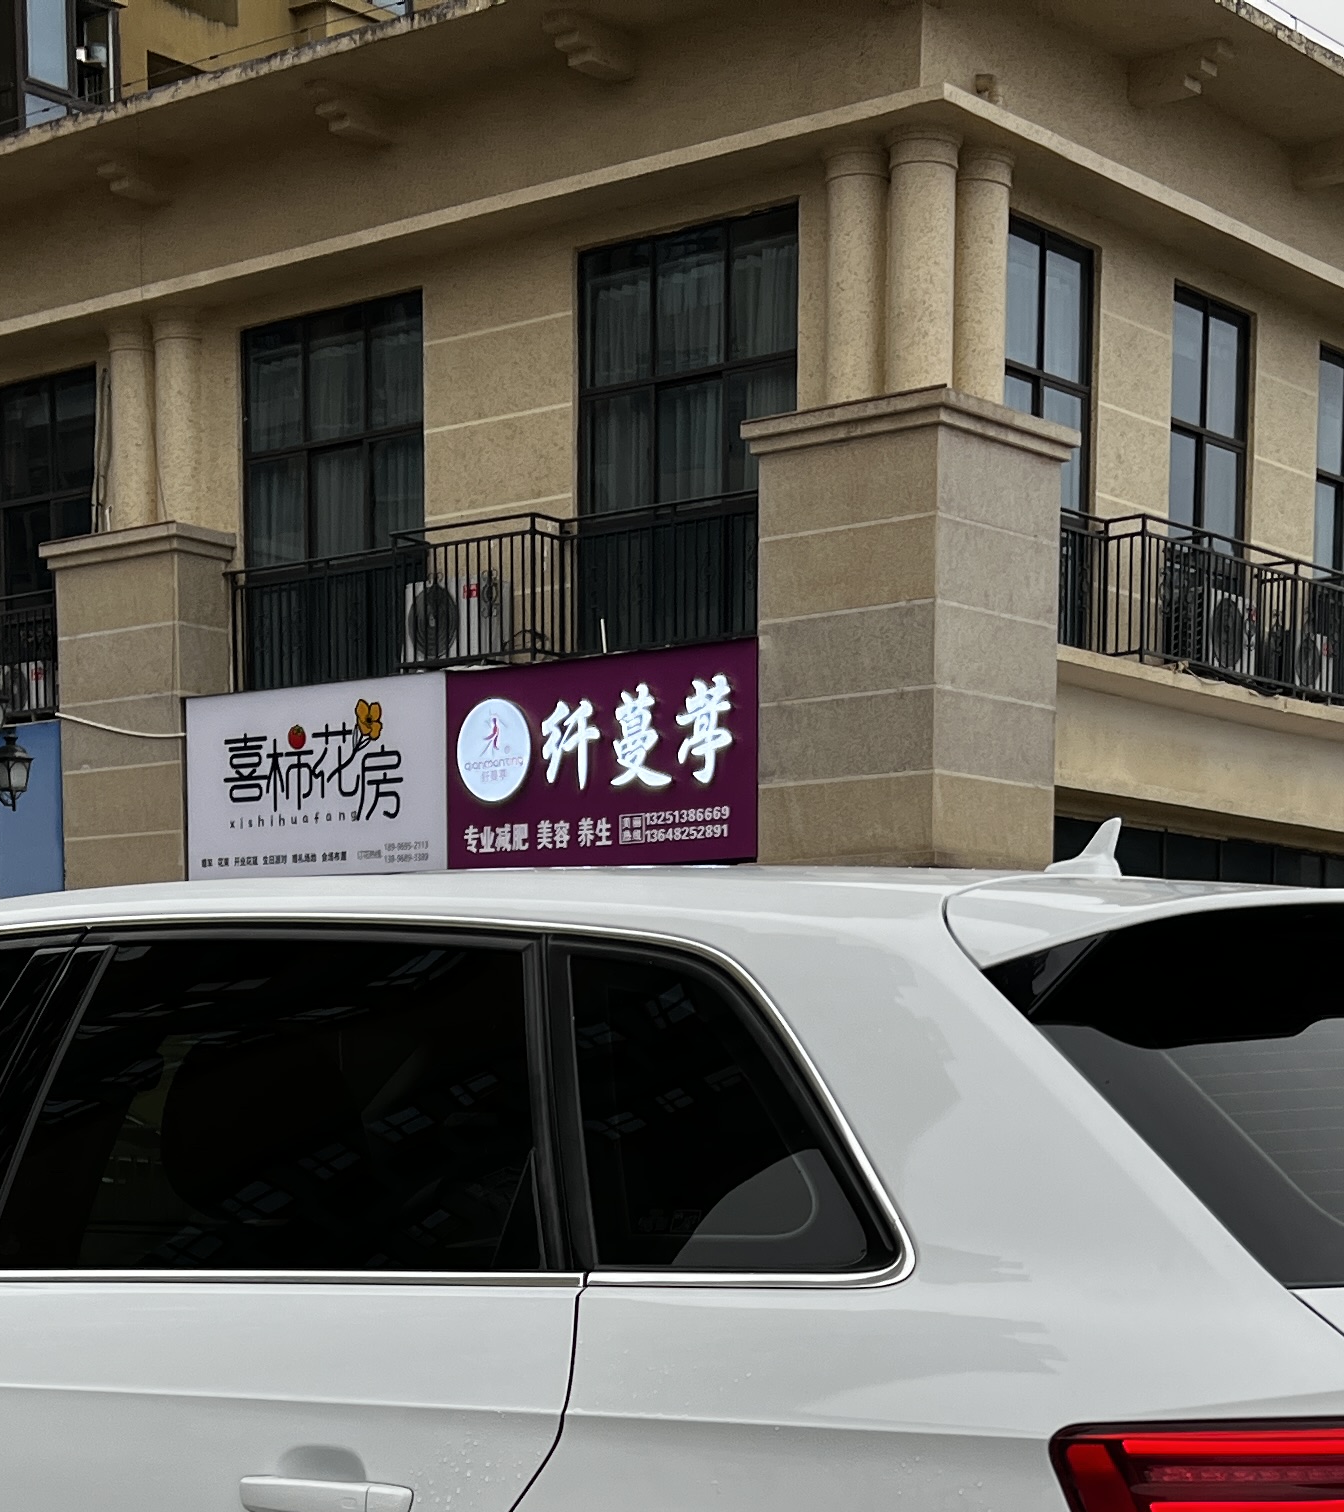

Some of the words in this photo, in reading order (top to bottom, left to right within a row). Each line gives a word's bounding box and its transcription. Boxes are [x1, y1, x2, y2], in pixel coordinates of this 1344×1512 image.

[223, 721, 404, 822] 喜柿花房
[644, 806, 730, 826] 13251386669
[464, 822, 529, 854] 专业减肥
[536, 819, 570, 849] 美容
[578, 817, 613, 847] 养生
[644, 824, 730, 844] 13648252891
